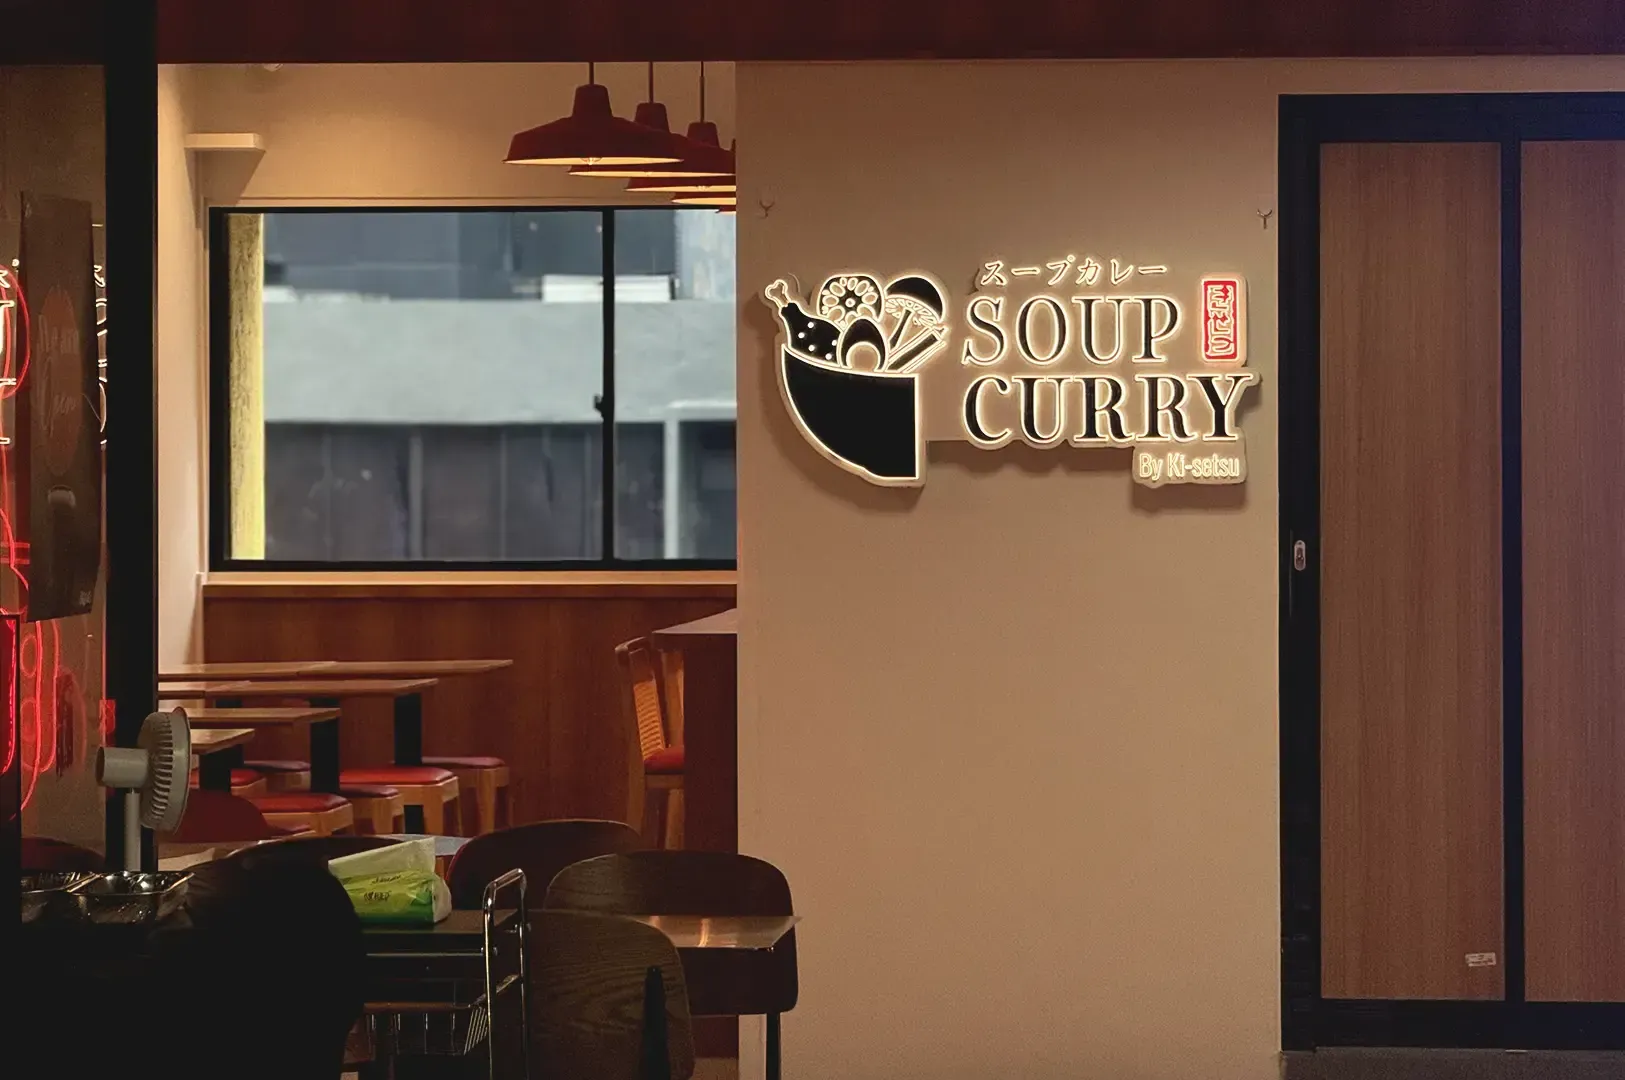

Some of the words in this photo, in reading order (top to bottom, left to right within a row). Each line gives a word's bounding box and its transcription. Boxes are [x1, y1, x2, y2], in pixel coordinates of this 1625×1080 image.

[980, 255, 1167, 286] スープカレー
[962, 295, 1181, 364] SOUP
[962, 374, 1253, 443] CURRY
[1139, 453, 1163, 481] By
[1167, 453, 1240, 478] Ki-setsu
